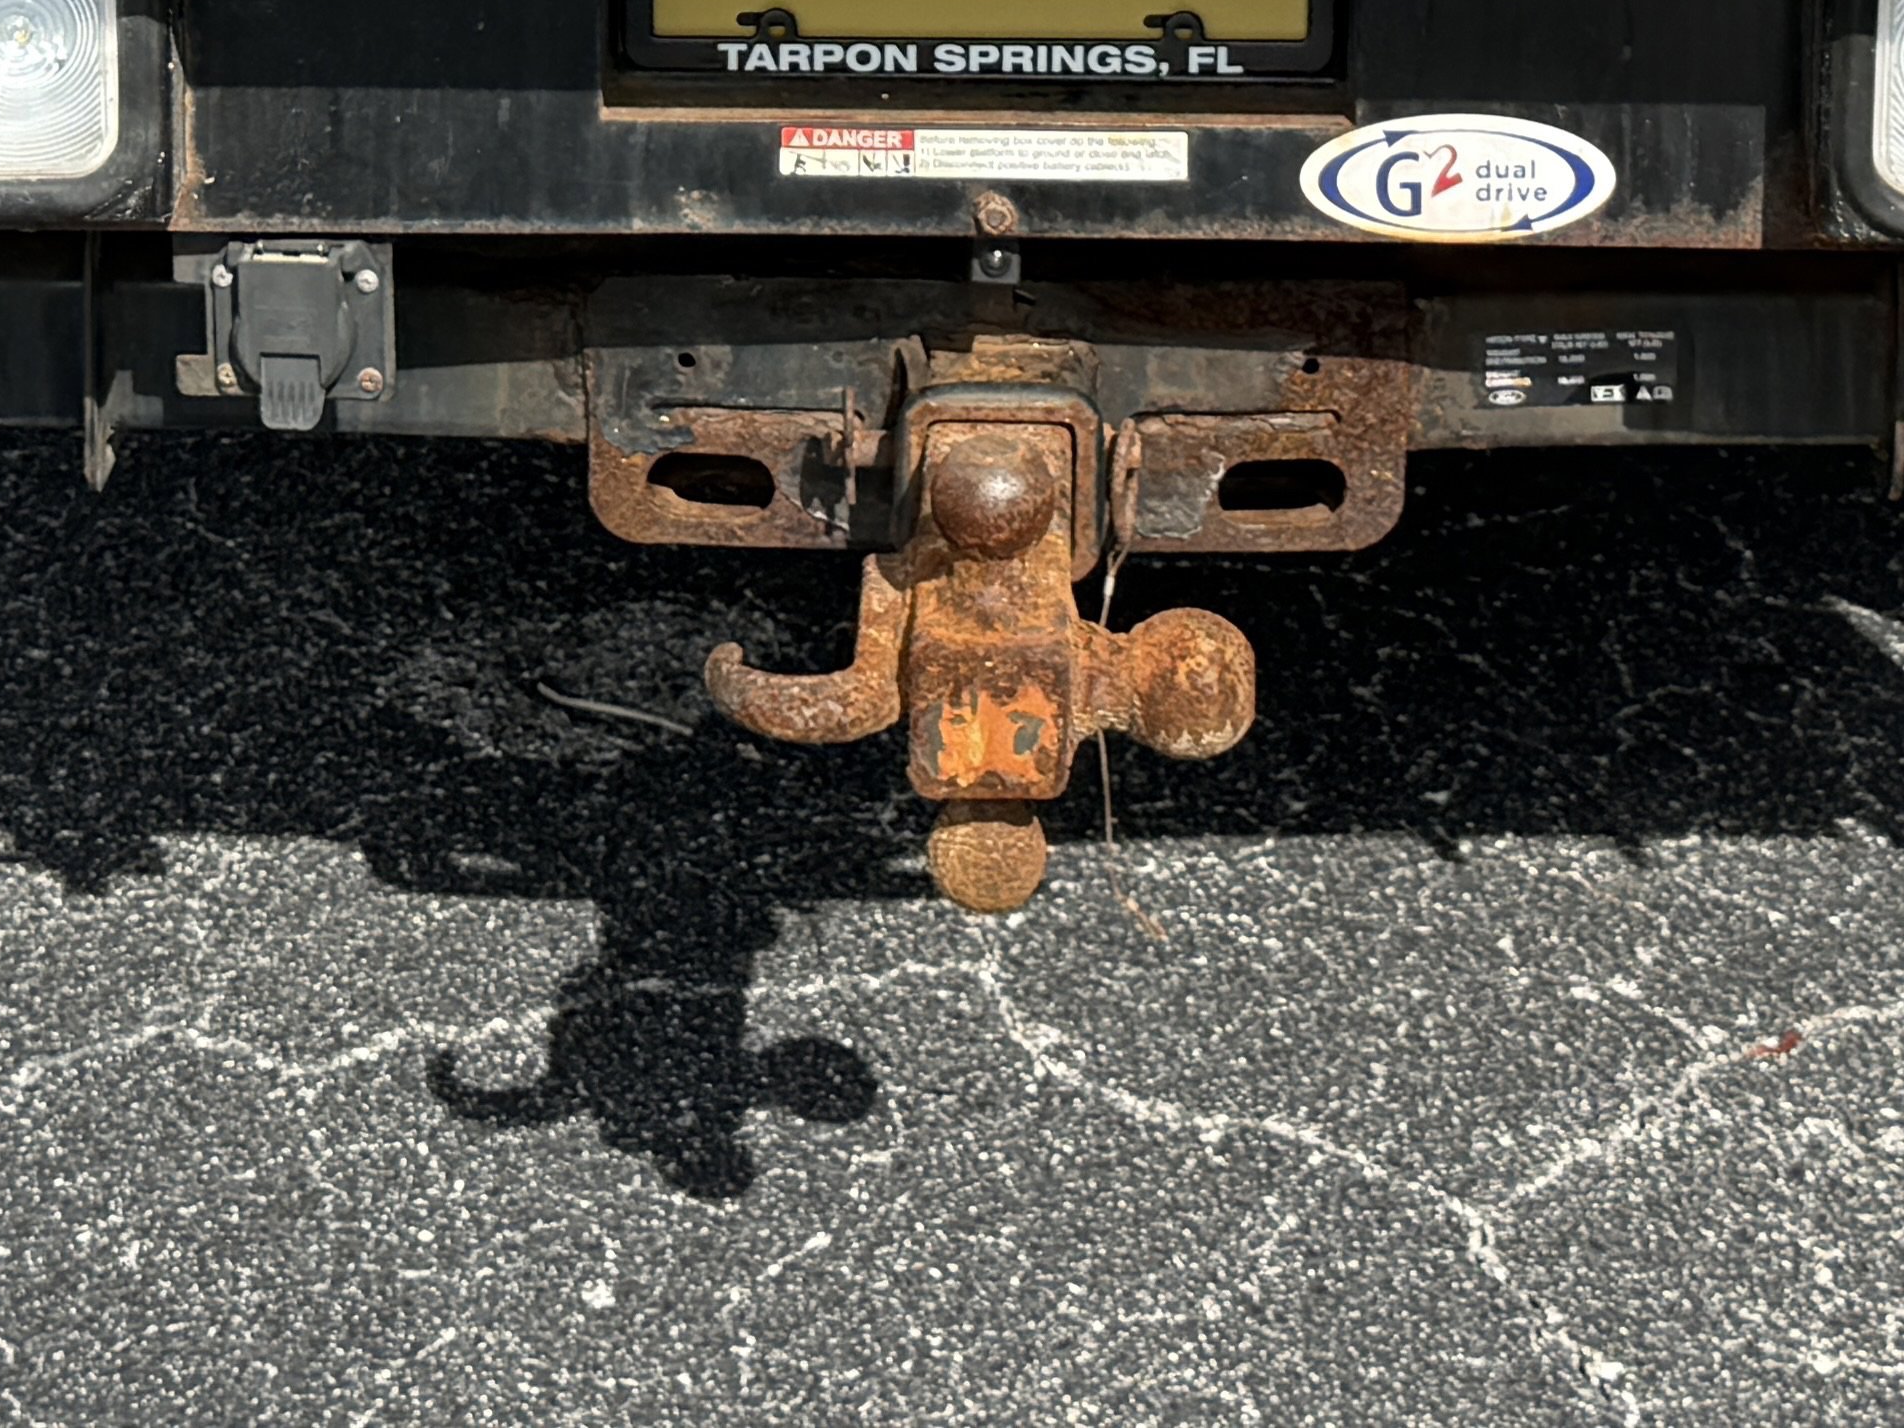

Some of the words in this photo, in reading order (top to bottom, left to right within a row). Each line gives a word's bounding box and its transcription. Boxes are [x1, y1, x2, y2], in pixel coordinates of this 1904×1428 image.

[717, 43, 919, 72] TARPON
[933, 44, 1170, 78] SPRINGS,
[1188, 46, 1244, 74] FL
[812, 130, 903, 148] DANGER
[1475, 160, 1537, 180] dual
[1475, 183, 1548, 202] drive
